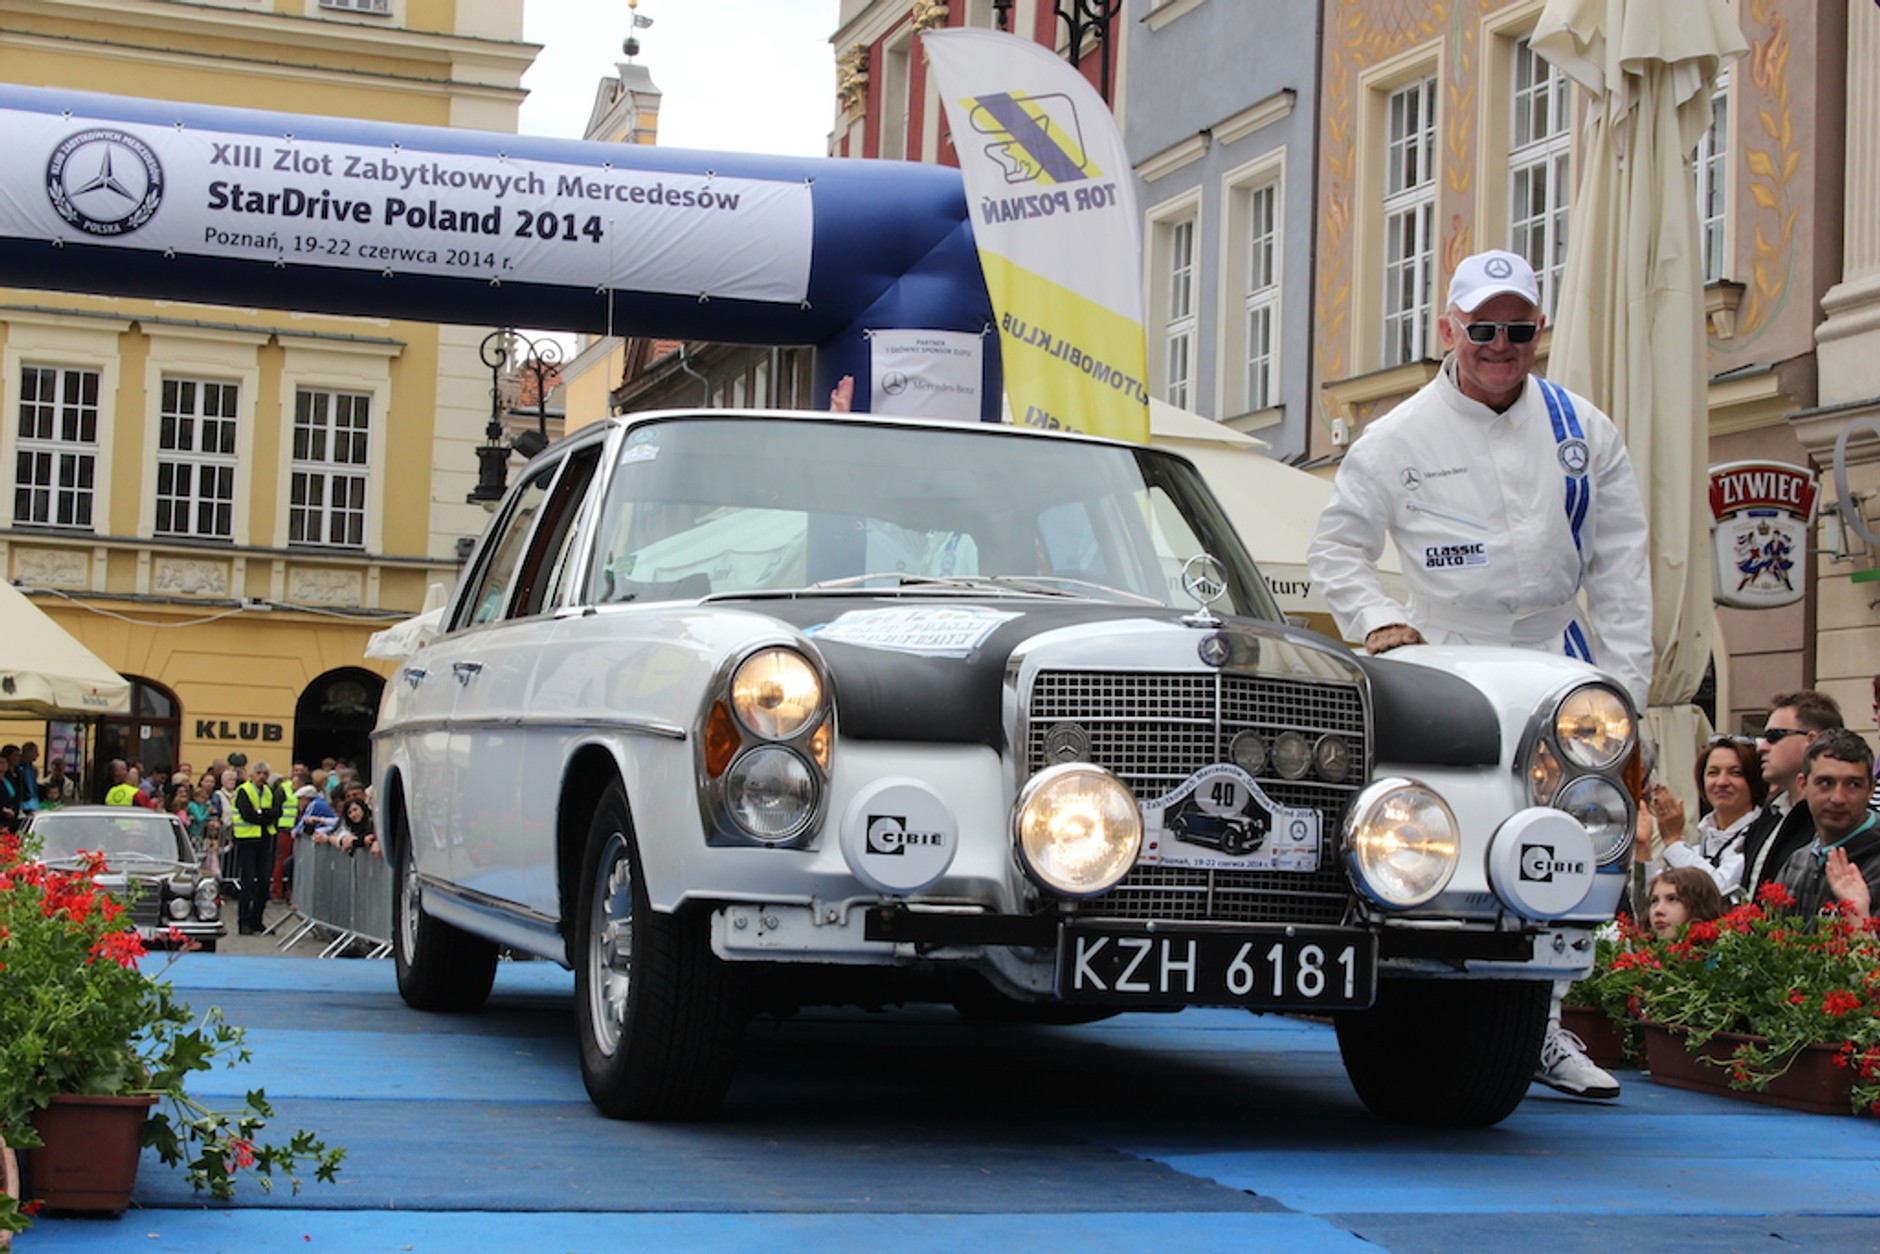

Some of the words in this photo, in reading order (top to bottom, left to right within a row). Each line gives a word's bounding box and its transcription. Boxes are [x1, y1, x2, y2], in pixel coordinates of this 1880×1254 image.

[61, 131, 122, 153] ZABYTKOWYCH
[210, 143, 262, 169] XIII
[273, 148, 333, 176] Zlot
[343, 155, 545, 199] Zabytkowych
[557, 174, 741, 211] Mercedesów
[82, 220, 122, 233] POLSKA
[207, 180, 372, 224] StarDrive
[384, 197, 502, 235] Poland
[515, 209, 604, 243] 2014
[204, 226, 284, 253] Poznań,
[293, 235, 351, 257] 19-22
[358, 243, 437, 264] czerwca
[445, 249, 495, 268] 2014
[502, 255, 514, 270] r.
[1718, 472, 1804, 505] ŻYWIEC
[196, 719, 283, 741] KLUB
[1211, 782, 1235, 807] 40
[1073, 936, 1198, 993] KZH
[1226, 941, 1356, 999] 6181
